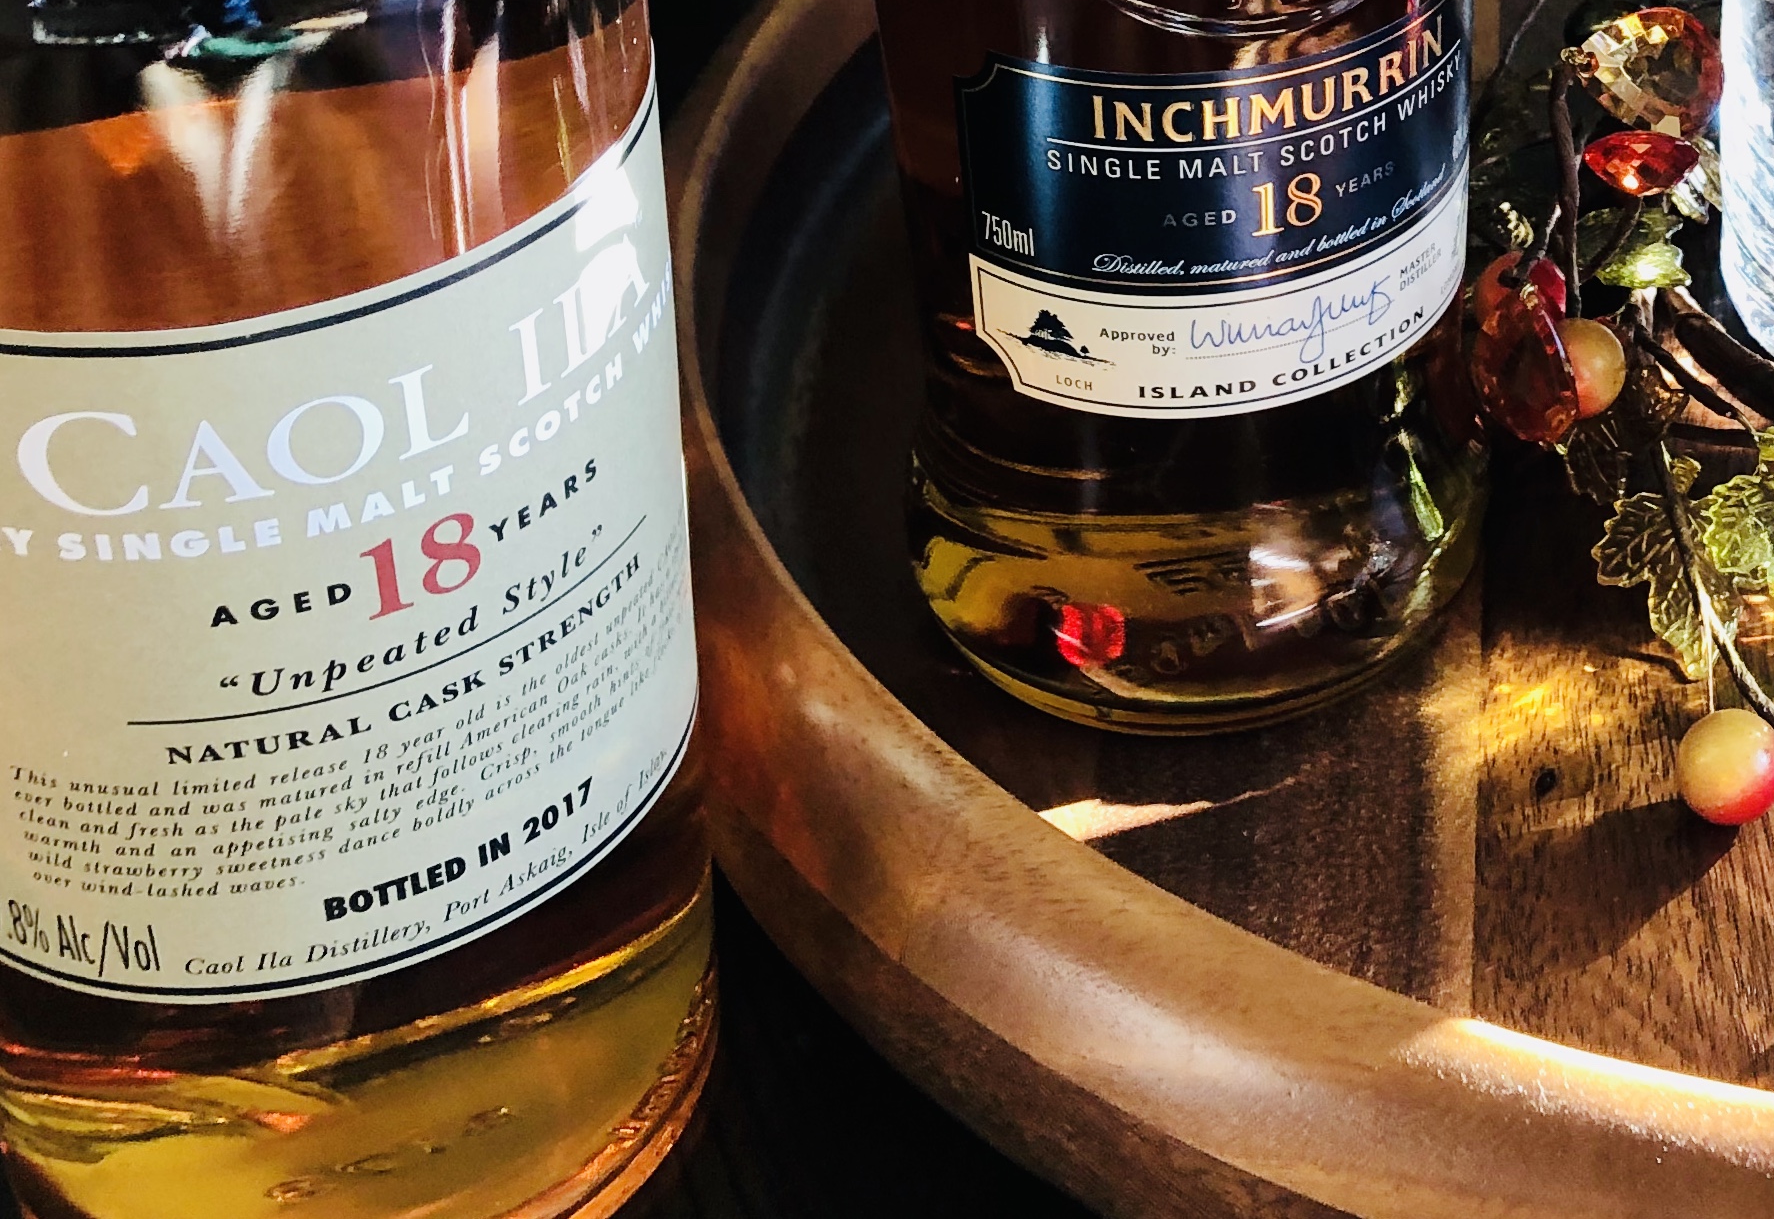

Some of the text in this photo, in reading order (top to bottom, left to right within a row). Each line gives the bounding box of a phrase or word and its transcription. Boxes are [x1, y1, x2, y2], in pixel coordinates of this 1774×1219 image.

[1047, 49, 1463, 181] SINGLE MALT SCOTCH WHISKY
[1092, 13, 1446, 144] INCHMURRIN
[981, 210, 1036, 258] 750ml
[1092, 253, 1186, 277] Distilled,
[1190, 254, 1271, 275] matured
[1275, 240, 1313, 268] and
[1315, 223, 1370, 258] bottled
[1370, 214, 1388, 237] in
[1162, 160, 1396, 238] AGED 18 YEARS
[1399, 241, 1437, 279] MASTER
[1099, 327, 1177, 343] Approved
[1399, 247, 1443, 292] DISTILLER
[1055, 374, 1094, 392] LOCH
[1138, 378, 1258, 400] ISLAND
[1272, 305, 1427, 388] COLLECTION
[1152, 342, 1178, 356] by:
[17, 363, 470, 518] CAOL
[57, 518, 295, 563] SINGLE
[305, 464, 456, 538] MALT
[479, 352, 624, 476] SCOTCH
[210, 457, 599, 629] AGED 18 YEARS
[10, 764, 57, 789] This
[69, 779, 159, 797] unusual
[173, 773, 257, 797] limited
[269, 758, 348, 786] release
[363, 743, 389, 765] 18
[399, 727, 445, 758] year
[455, 703, 486, 730] old
[496, 694, 511, 711] is
[521, 673, 547, 697] the
[555, 632, 599, 675] oldest
[167, 716, 374, 766] NATURAL
[388, 669, 487, 723] CASK
[498, 552, 641, 677] STRENGTH
[14, 790, 54, 808] ever
[63, 795, 137, 817] bottled
[150, 801, 191, 817] and
[203, 799, 248, 815] was
[259, 775, 353, 810] matured
[364, 769, 385, 785] in
[396, 740, 451, 776] refill
[459, 693, 548, 751] American
[557, 662, 588, 694] Oak
[19, 809, 71, 831] clean
[80, 820, 120, 836] and
[124, 821, 185, 841] fresh
[194, 824, 219, 837] as
[231, 817, 264, 834] the
[273, 806, 324, 832] pale
[334, 793, 369, 814] sky
[380, 775, 423, 801] that
[428, 741, 504, 788] follows
[511, 690, 580, 745] clearing
[24, 830, 101, 855] warmth
[115, 843, 156, 858] and
[170, 845, 198, 857] an
[212, 826, 335, 859] appetising
[349, 804, 403, 832] salty
[548, 693, 602, 744] smooth
[28, 850, 73, 870] wild
[84, 860, 204, 881] strawberry
[215, 849, 327, 876] sweetness
[338, 826, 402, 855] dance
[412, 797, 475, 832] boldly
[485, 763, 541, 801] across
[549, 739, 574, 765] the
[580, 695, 625, 743] tongue
[33, 871, 306, 898] over wind-lashed waves.
[184, 954, 245, 976] Caol
[257, 951, 293, 972] Ila
[304, 917, 432, 965] Distillery,
[443, 887, 490, 923] Port
[498, 844, 574, 898] Askaig,
[581, 807, 611, 846] Isle
[615, 785, 633, 814] of
[323, 775, 594, 923] BOTTLED IN 2017
